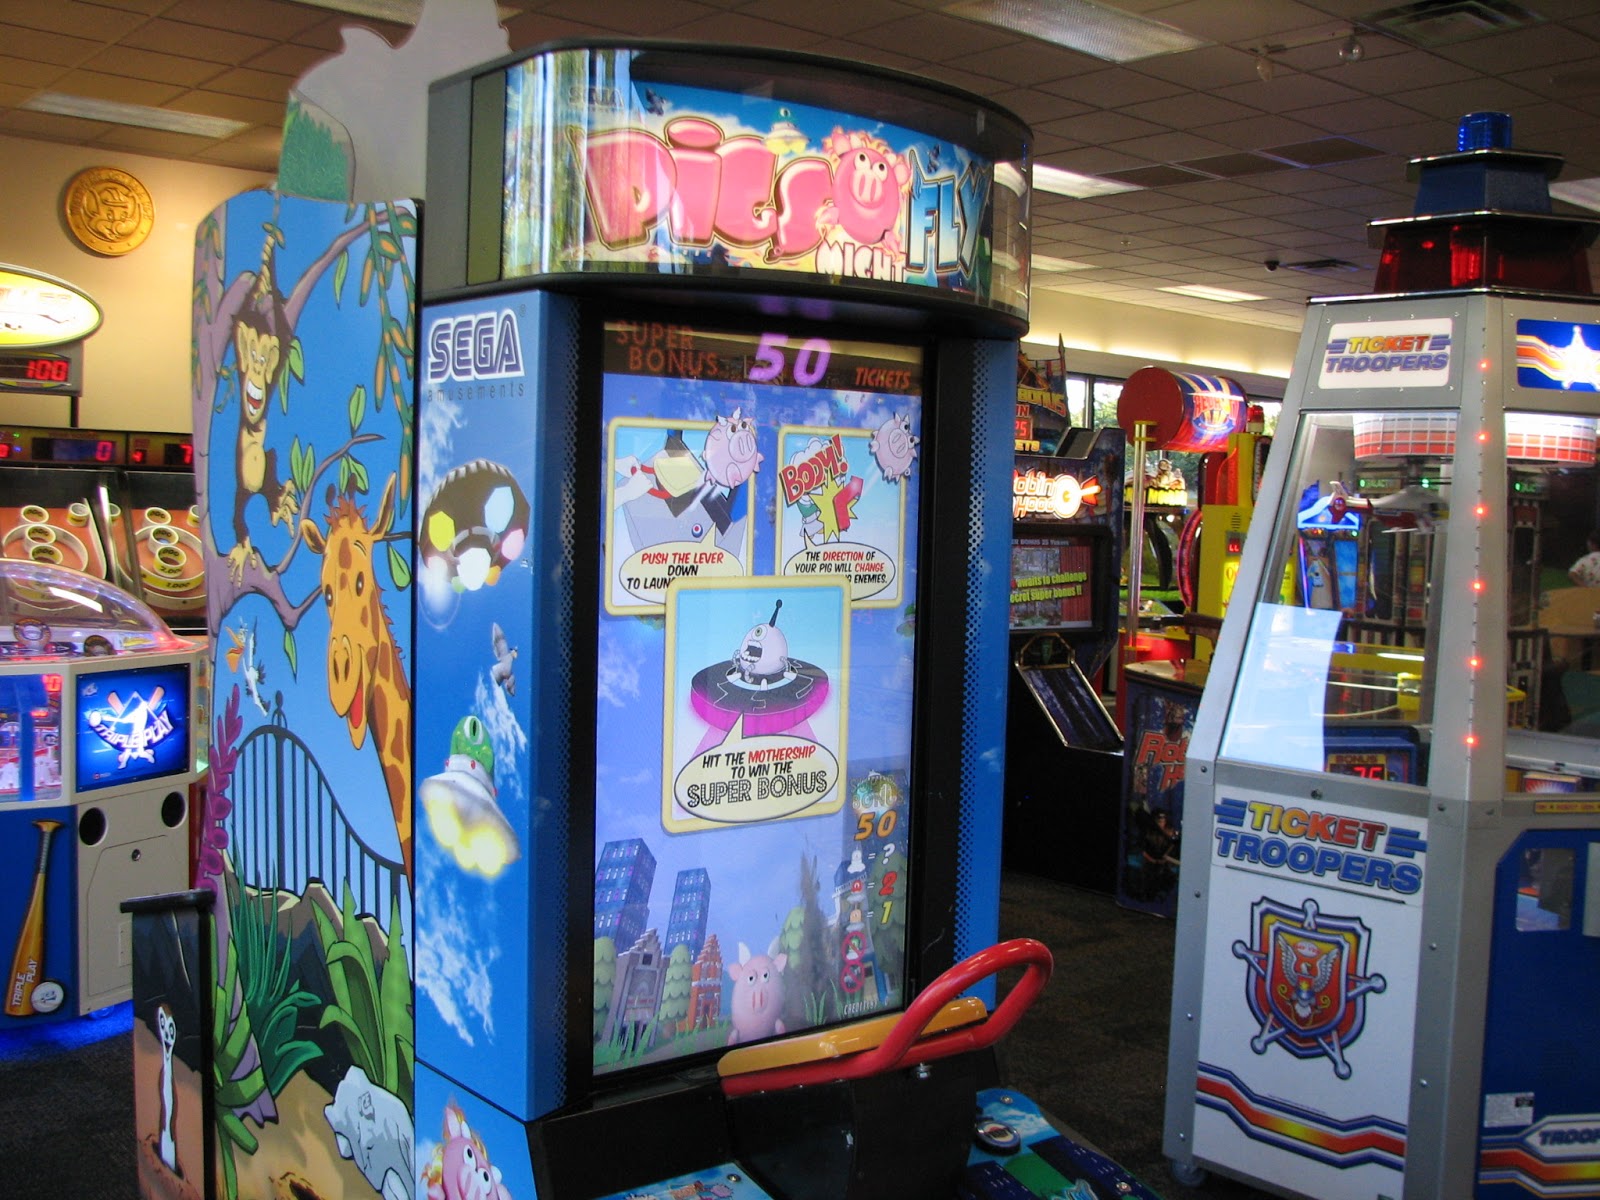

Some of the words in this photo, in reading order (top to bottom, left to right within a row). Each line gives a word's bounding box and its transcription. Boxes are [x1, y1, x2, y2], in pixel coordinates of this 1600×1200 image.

[905, 148, 993, 278] FLY
[428, 308, 525, 384] SEGA
[616, 320, 694, 350] SUPER
[1348, 333, 1430, 354] TICKET
[26, 360, 69, 382] 100
[629, 345, 719, 377] BONUS
[750, 332, 832, 386] 50
[1326, 352, 1449, 373] TROOPERS
[855, 366, 911, 390] TICKETS
[427, 382, 525, 402] amusements
[780, 434, 848, 506] BOOM!
[641, 552, 669, 565] PUSH
[672, 552, 691, 564] THE
[693, 551, 724, 564] LEVER
[795, 563, 816, 573] YOUR
[819, 563, 832, 573] PIG
[834, 563, 852, 572] WILL
[854, 562, 885, 572] CHANGE
[805, 551, 821, 561] THE
[822, 551, 864, 561] DIRECTION
[865, 551, 876, 561] OF
[667, 565, 699, 576] DOWN
[853, 574, 888, 584] ENEMIES.
[626, 577, 640, 590] TO
[643, 577, 674, 590] LAUN
[142, 708, 174, 747] PLAY
[702, 753, 721, 769] HIT
[724, 751, 746, 766] THE
[748, 745, 816, 764] MOTHERSHIP
[731, 765, 745, 779] TO
[748, 763, 770, 778] WIN
[773, 761, 794, 775] THE
[687, 778, 752, 808] SUPER
[757, 770, 828, 800] BONUS
[854, 809, 898, 841] 50
[1248, 800, 1388, 851] TICKET
[1214, 828, 1424, 895] TROOPERS
[25, 958, 38, 984] PLAY
[12, 972, 27, 1006] TRIPLE
